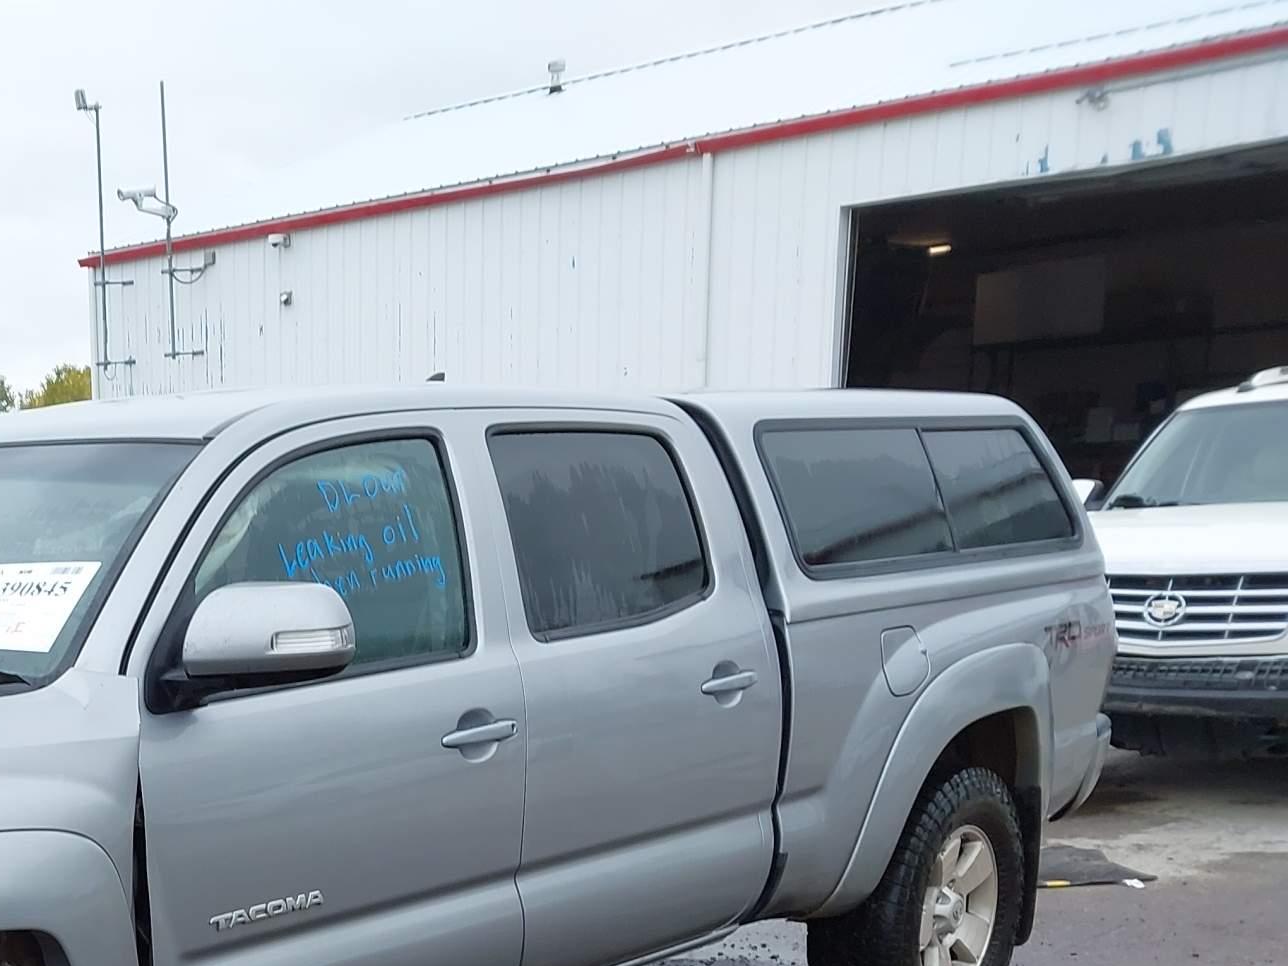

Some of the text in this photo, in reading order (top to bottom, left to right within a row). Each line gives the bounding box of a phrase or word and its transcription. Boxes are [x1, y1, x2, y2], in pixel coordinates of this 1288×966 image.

[279, 504, 420, 578] Leaking oil
[370, 554, 447, 589] running
[209, 889, 324, 931] TACOMA
